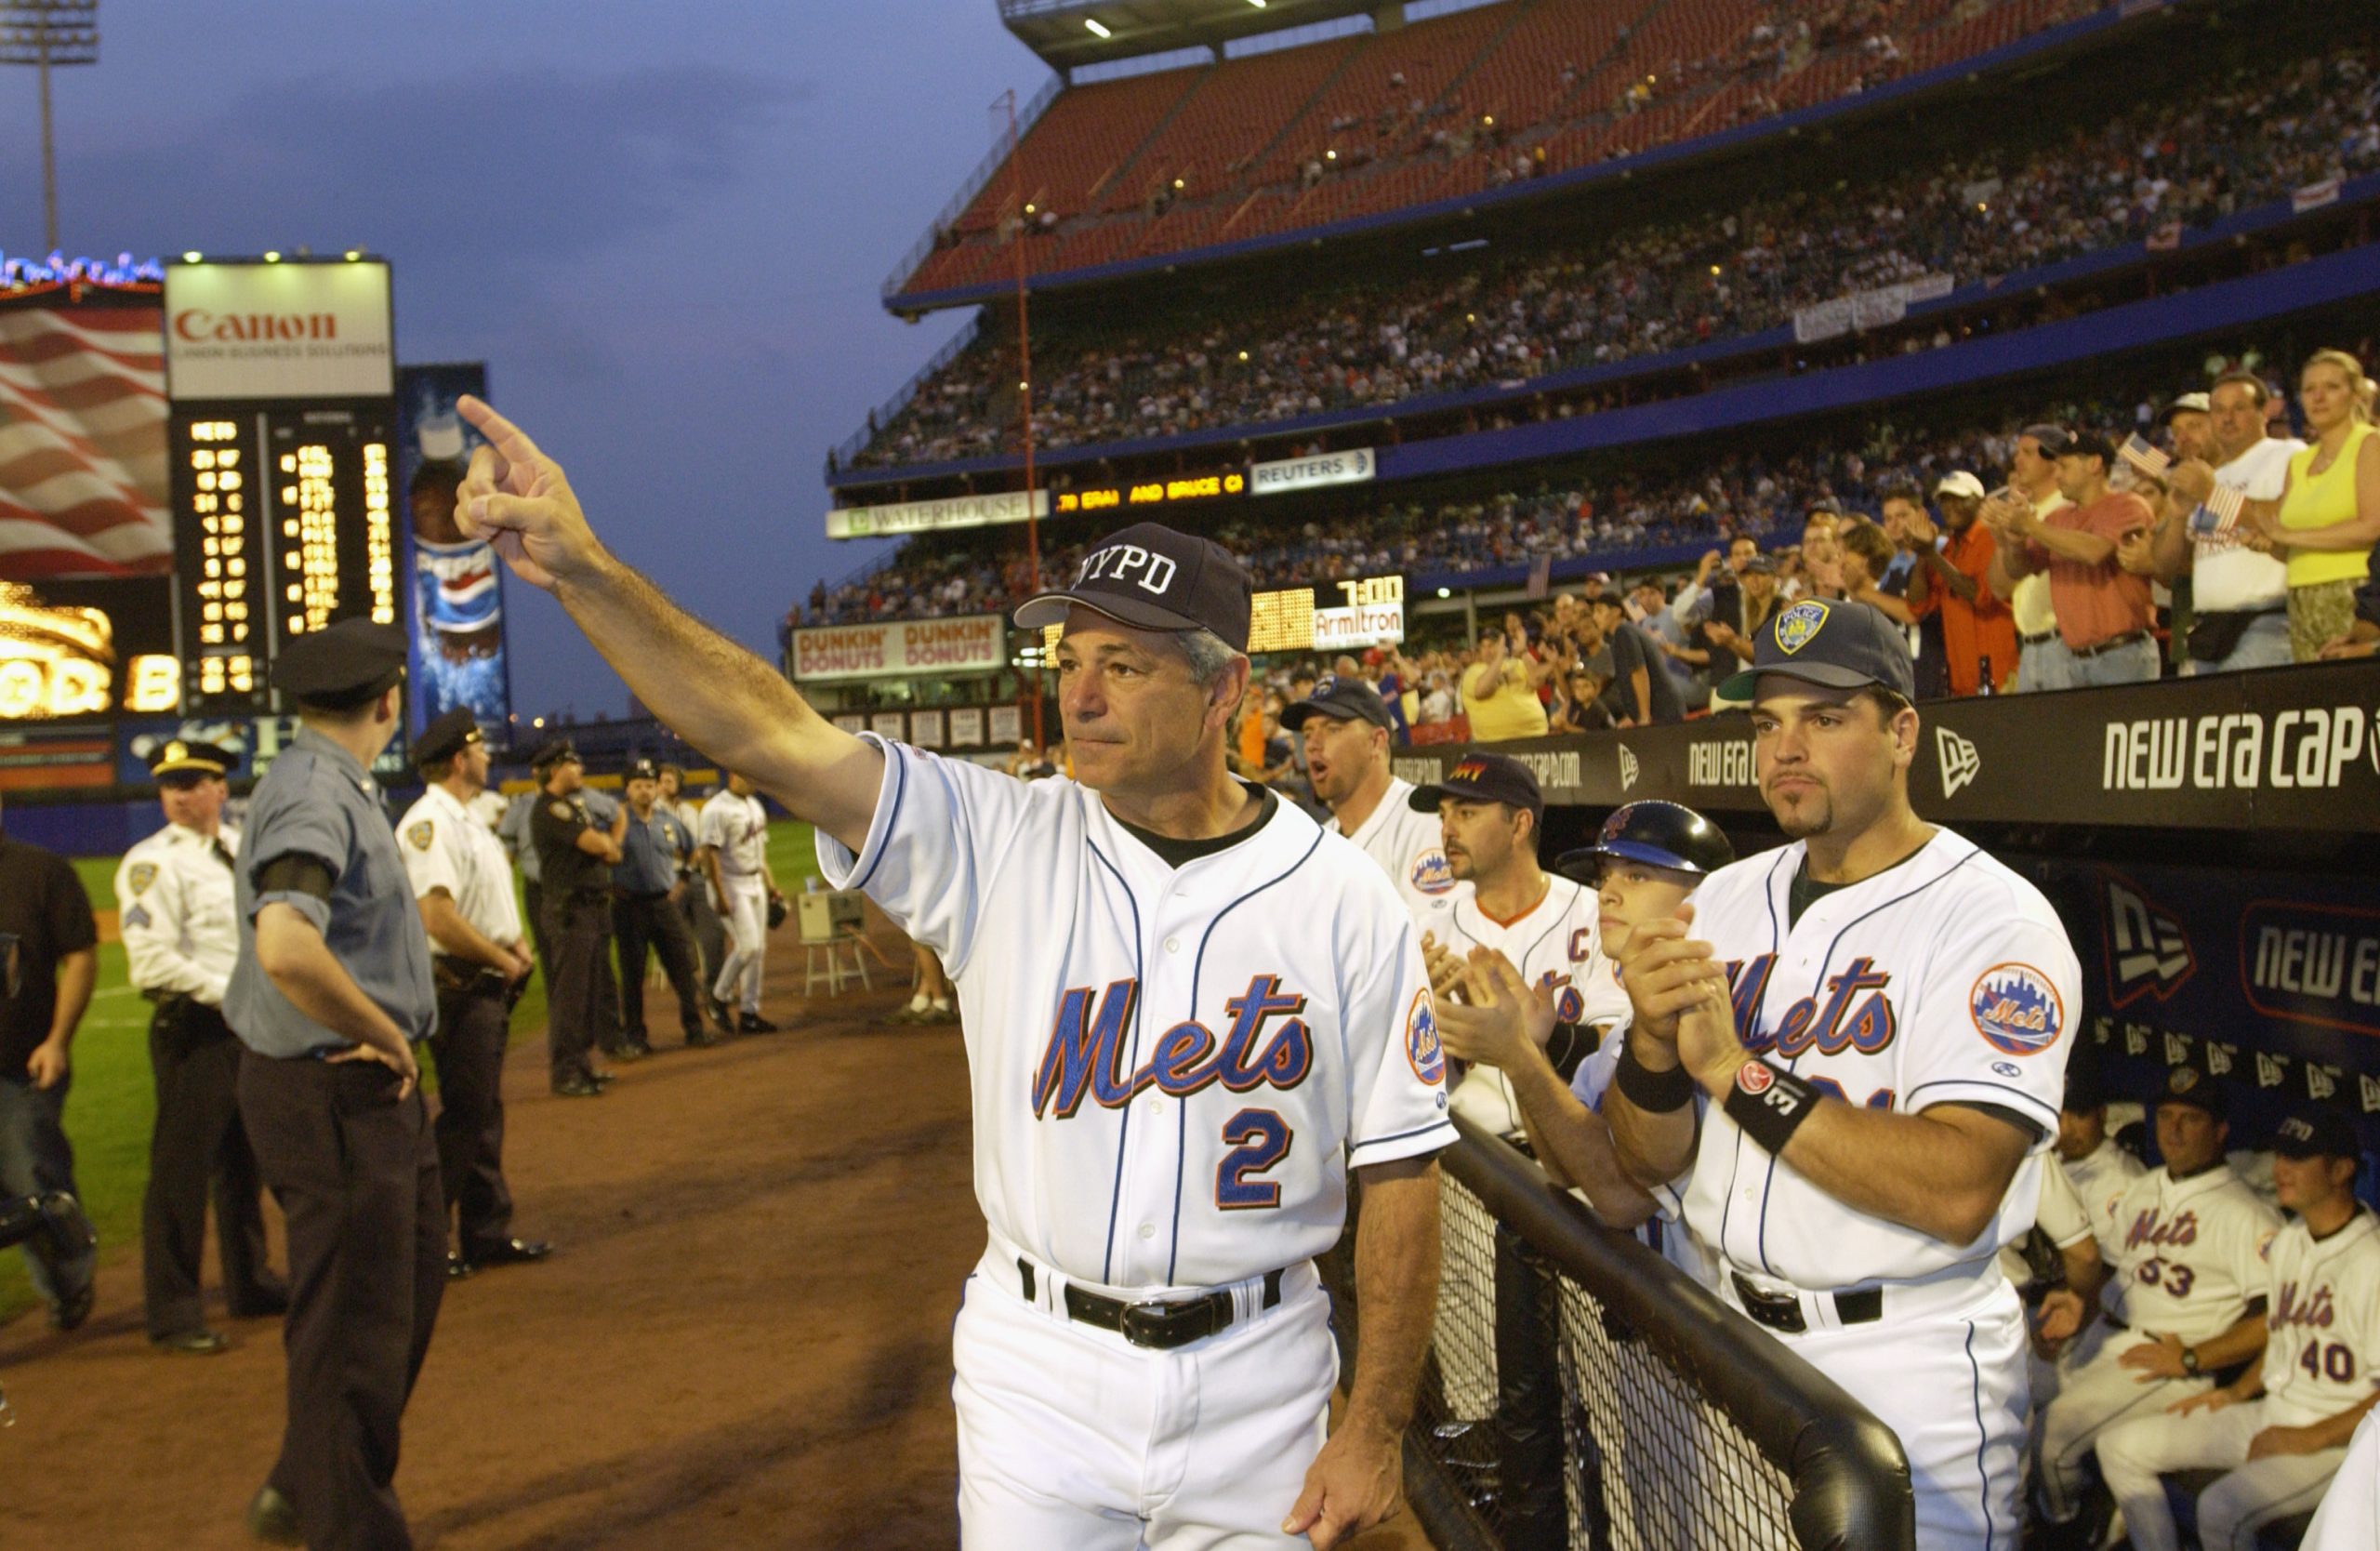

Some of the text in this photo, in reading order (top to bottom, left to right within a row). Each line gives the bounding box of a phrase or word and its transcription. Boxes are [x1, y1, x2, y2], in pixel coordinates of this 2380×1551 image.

[175, 309, 337, 342] Canon
[1259, 458, 1344, 484] REUTERS
[1130, 484, 1164, 504] AND
[1168, 476, 1221, 500] BRUCE
[874, 496, 1024, 529] WATERHOUSE
[1070, 544, 1177, 595] NYPD
[1337, 575, 1403, 606] 7:00
[799, 628, 887, 652] DUNKIN'
[905, 620, 997, 645] DUNKIN'
[800, 648, 884, 673] DONUTS
[906, 642, 992, 666] DONUTS
[1568, 927, 1590, 962] C
[1982, 998, 2046, 1031] Mets
[1032, 974, 1313, 1120] Mets
[1215, 1107, 1293, 1211] 2
[2125, 1208, 2198, 1251] Mets
[2138, 1256, 2195, 1298] 53
[2268, 1281, 2334, 1332] Mets
[2301, 1338, 2355, 1383] 40
